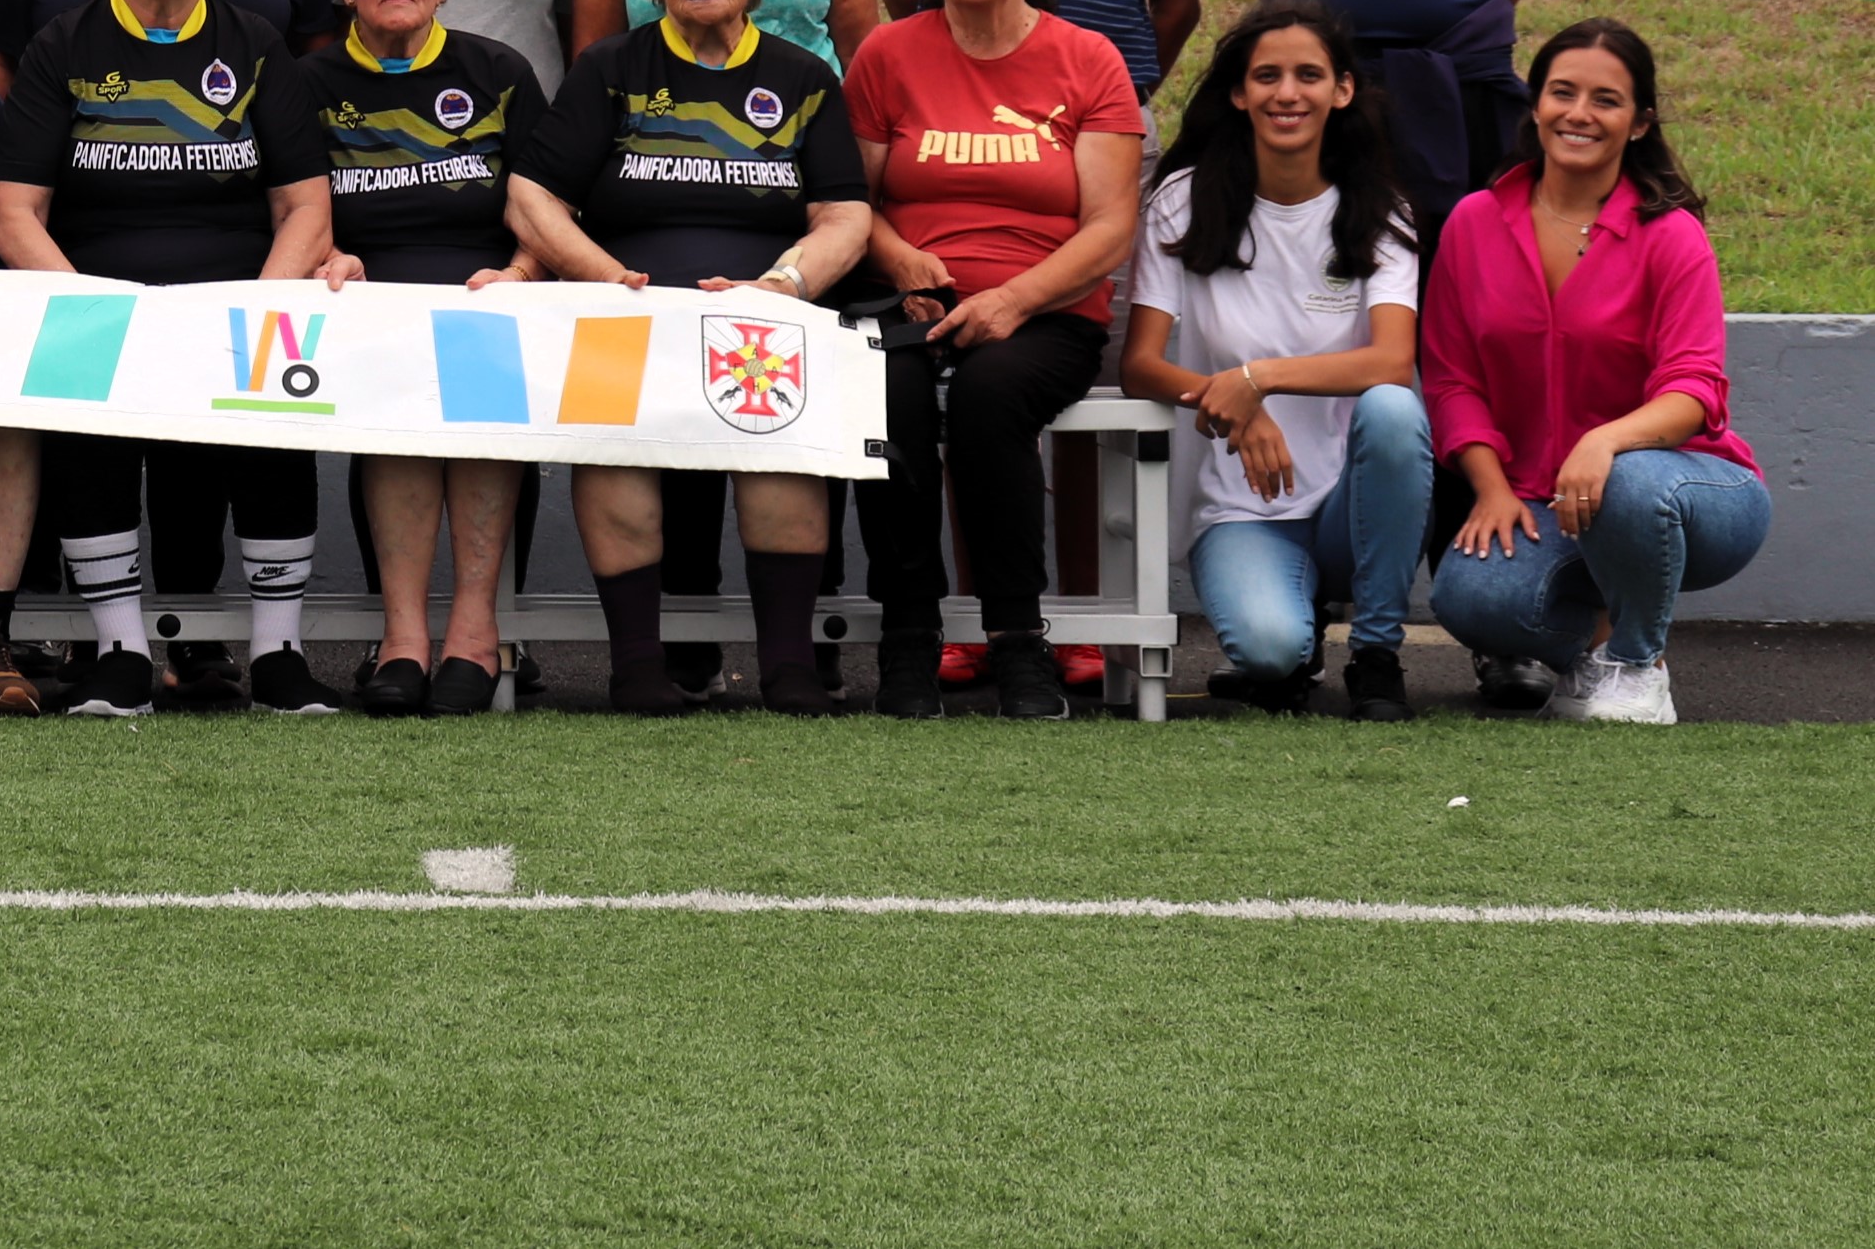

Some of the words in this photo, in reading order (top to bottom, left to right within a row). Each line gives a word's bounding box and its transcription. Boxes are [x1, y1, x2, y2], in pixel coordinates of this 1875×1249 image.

[98, 85, 127, 94] SPORT
[72, 142, 182, 171] PANIFICADORA
[186, 139, 258, 171] FETEIRENSE
[917, 129, 1041, 164] PUMA
[422, 155, 493, 184] FETEIRENSE
[619, 154, 723, 184] PANIFICADORA
[725, 161, 798, 187] FETEIRENSE
[260, 566, 289, 575] NIKE
